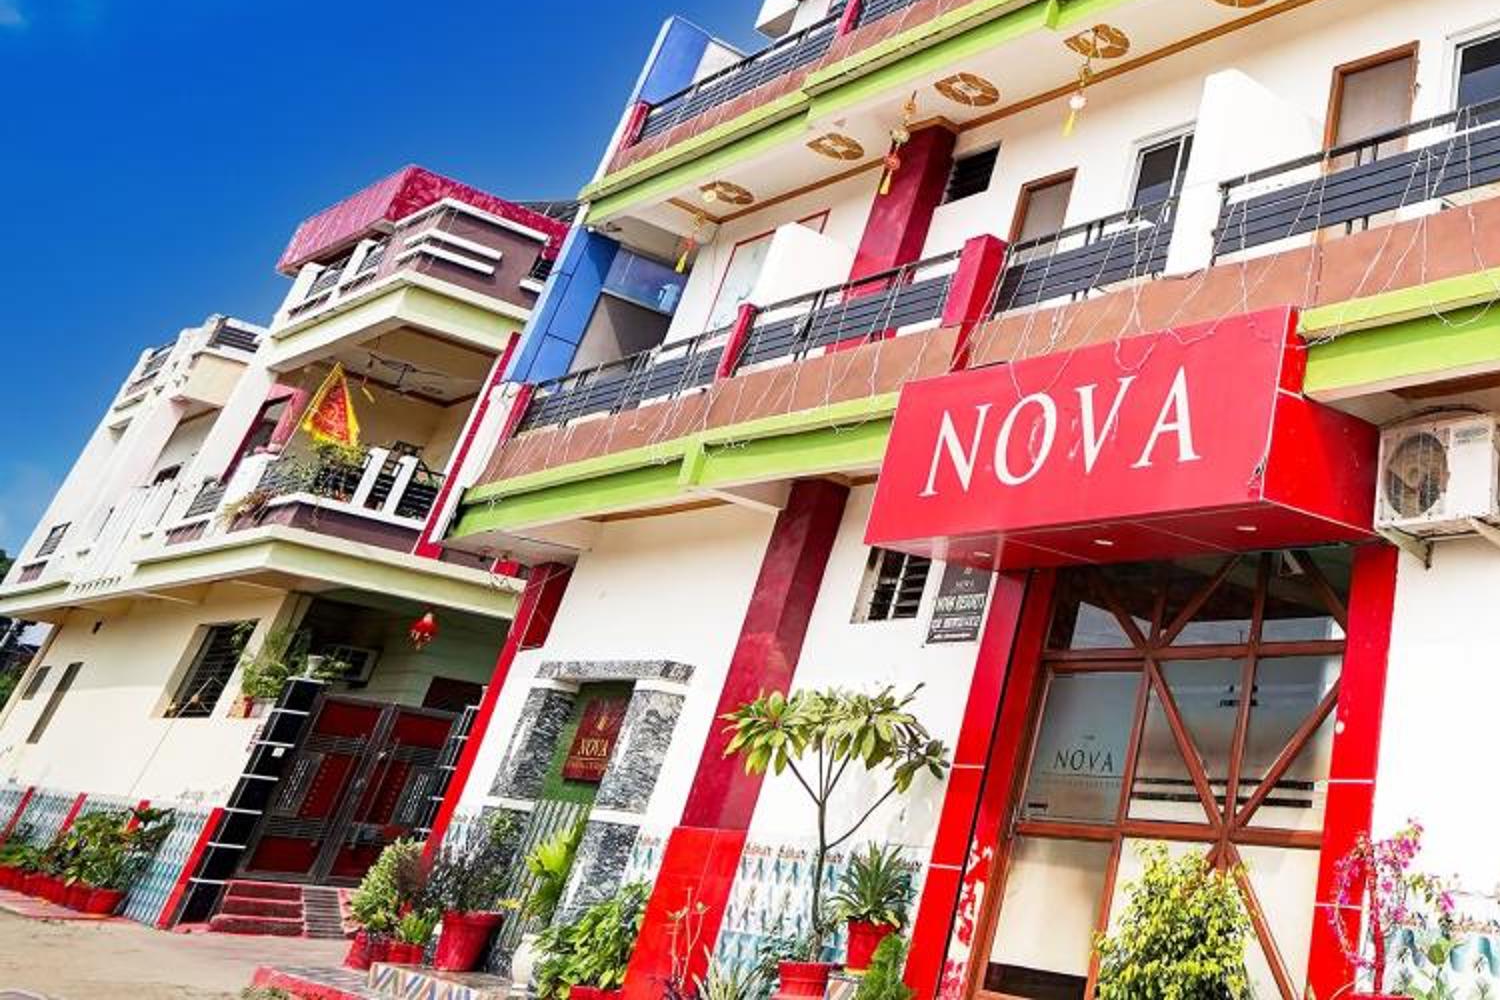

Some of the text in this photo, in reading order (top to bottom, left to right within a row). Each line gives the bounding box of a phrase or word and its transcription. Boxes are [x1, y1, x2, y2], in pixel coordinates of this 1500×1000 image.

[918, 365, 1201, 497] NOVA
[578, 738, 609, 757] NOVA
[1054, 749, 1114, 773] NOVA
